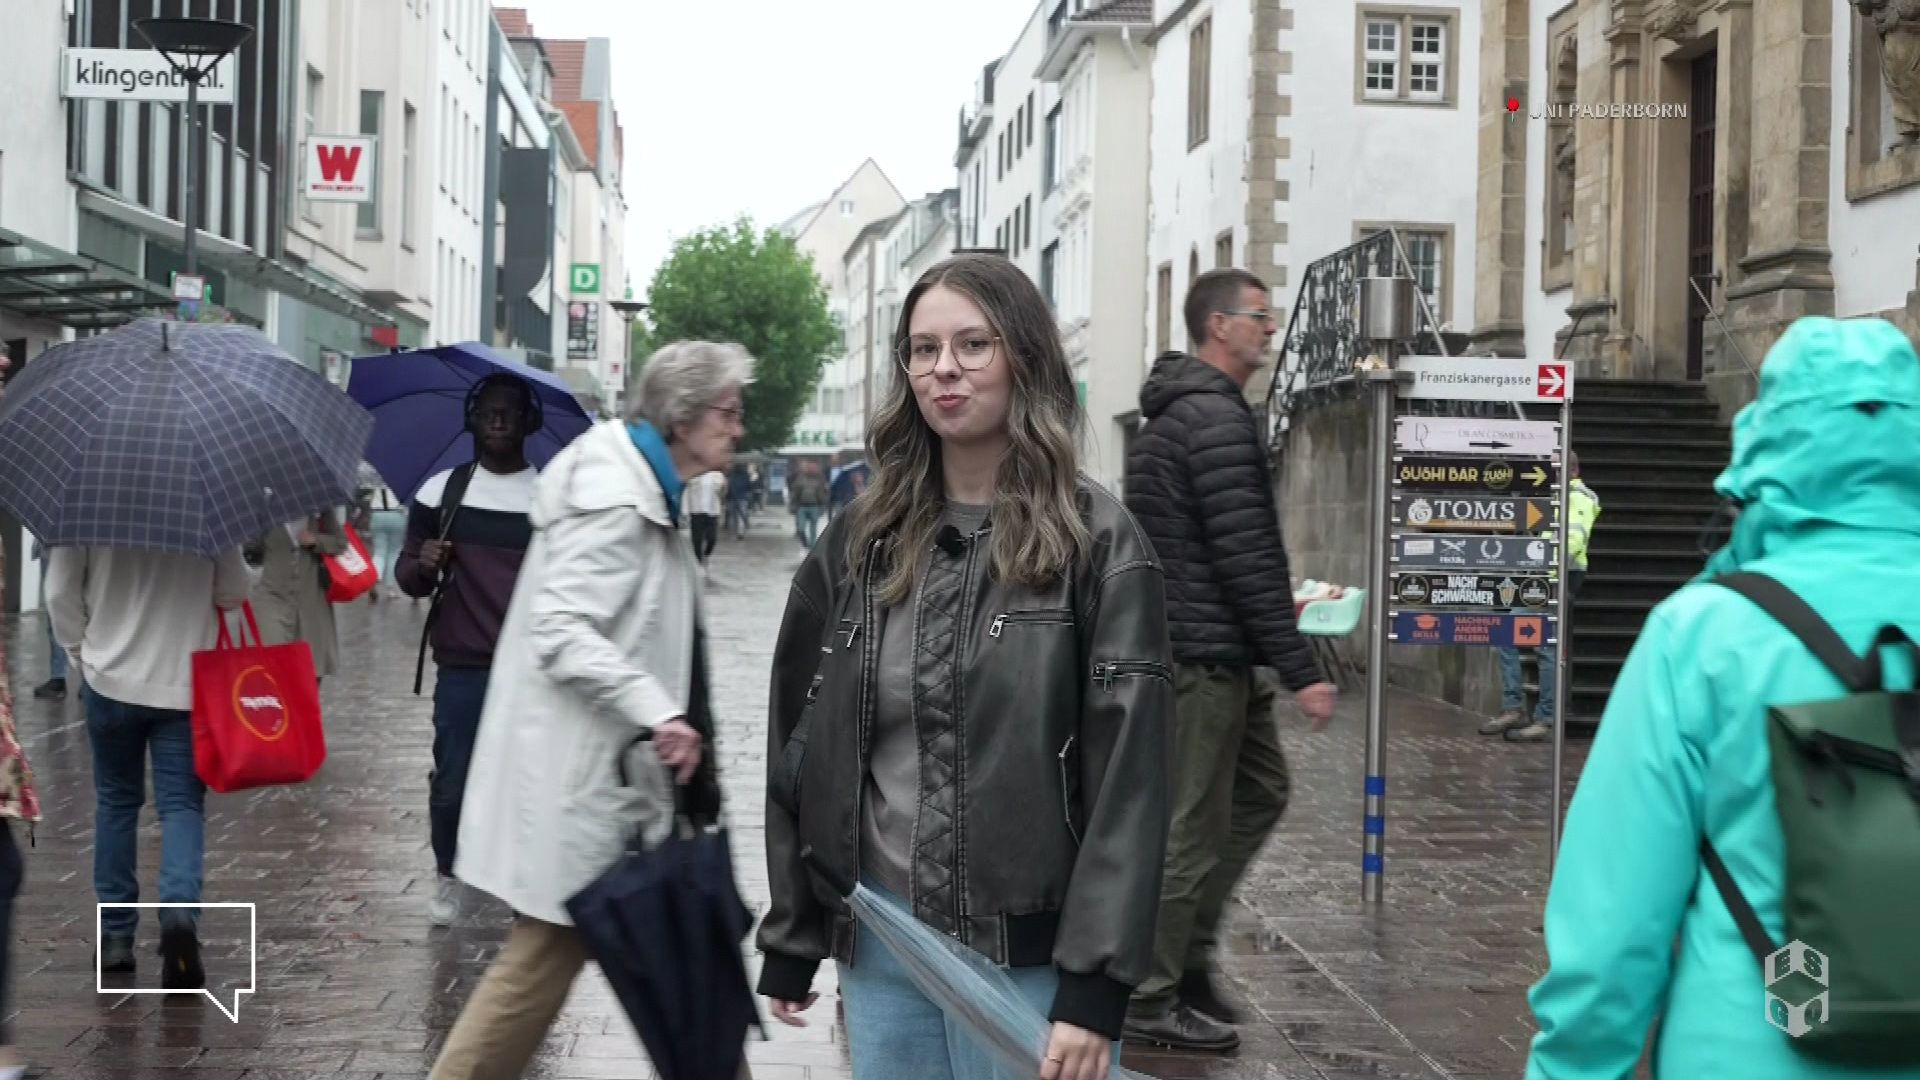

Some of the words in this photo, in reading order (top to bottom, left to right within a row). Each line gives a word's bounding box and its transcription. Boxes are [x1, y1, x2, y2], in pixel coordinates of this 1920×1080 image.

[317, 145, 362, 181] W
[574, 268, 596, 288] D
[1420, 371, 1532, 387] Franziskanergasse
[1400, 465, 1446, 482] SUSHI
[1448, 466, 1479, 482] BAR
[1482, 468, 1514, 482] ZUSHI
[1434, 500, 1515, 520] TOMS
[1447, 576, 1478, 589] NACHT
[1431, 588, 1494, 606] SCHWÄRMER
